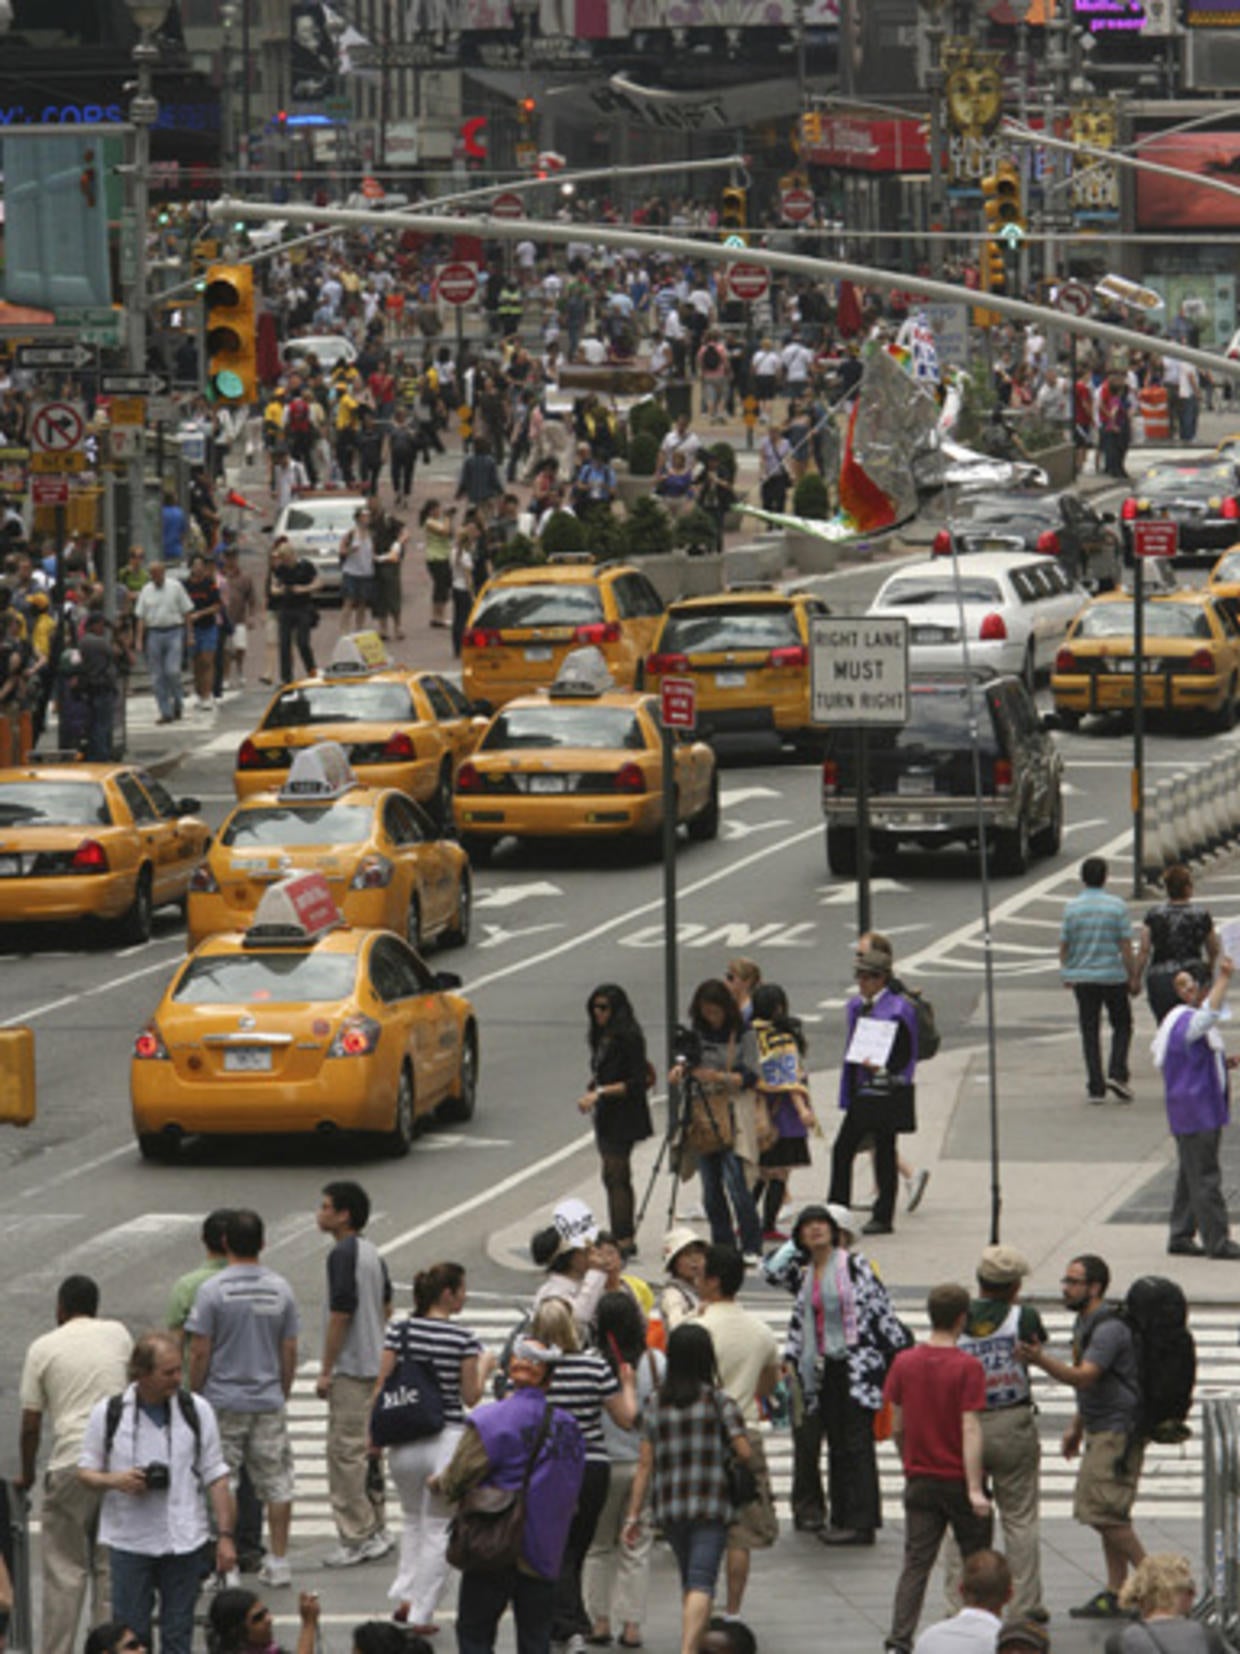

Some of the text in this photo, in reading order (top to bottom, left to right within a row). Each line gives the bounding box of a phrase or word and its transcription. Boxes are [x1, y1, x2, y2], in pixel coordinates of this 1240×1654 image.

[950, 136, 1002, 154] KING
[951, 155, 1002, 177] TUT
[815, 630, 902, 649] RIGHT LANE
[833, 659, 883, 680] MUST
[816, 692, 903, 709] TURN RIGHT
